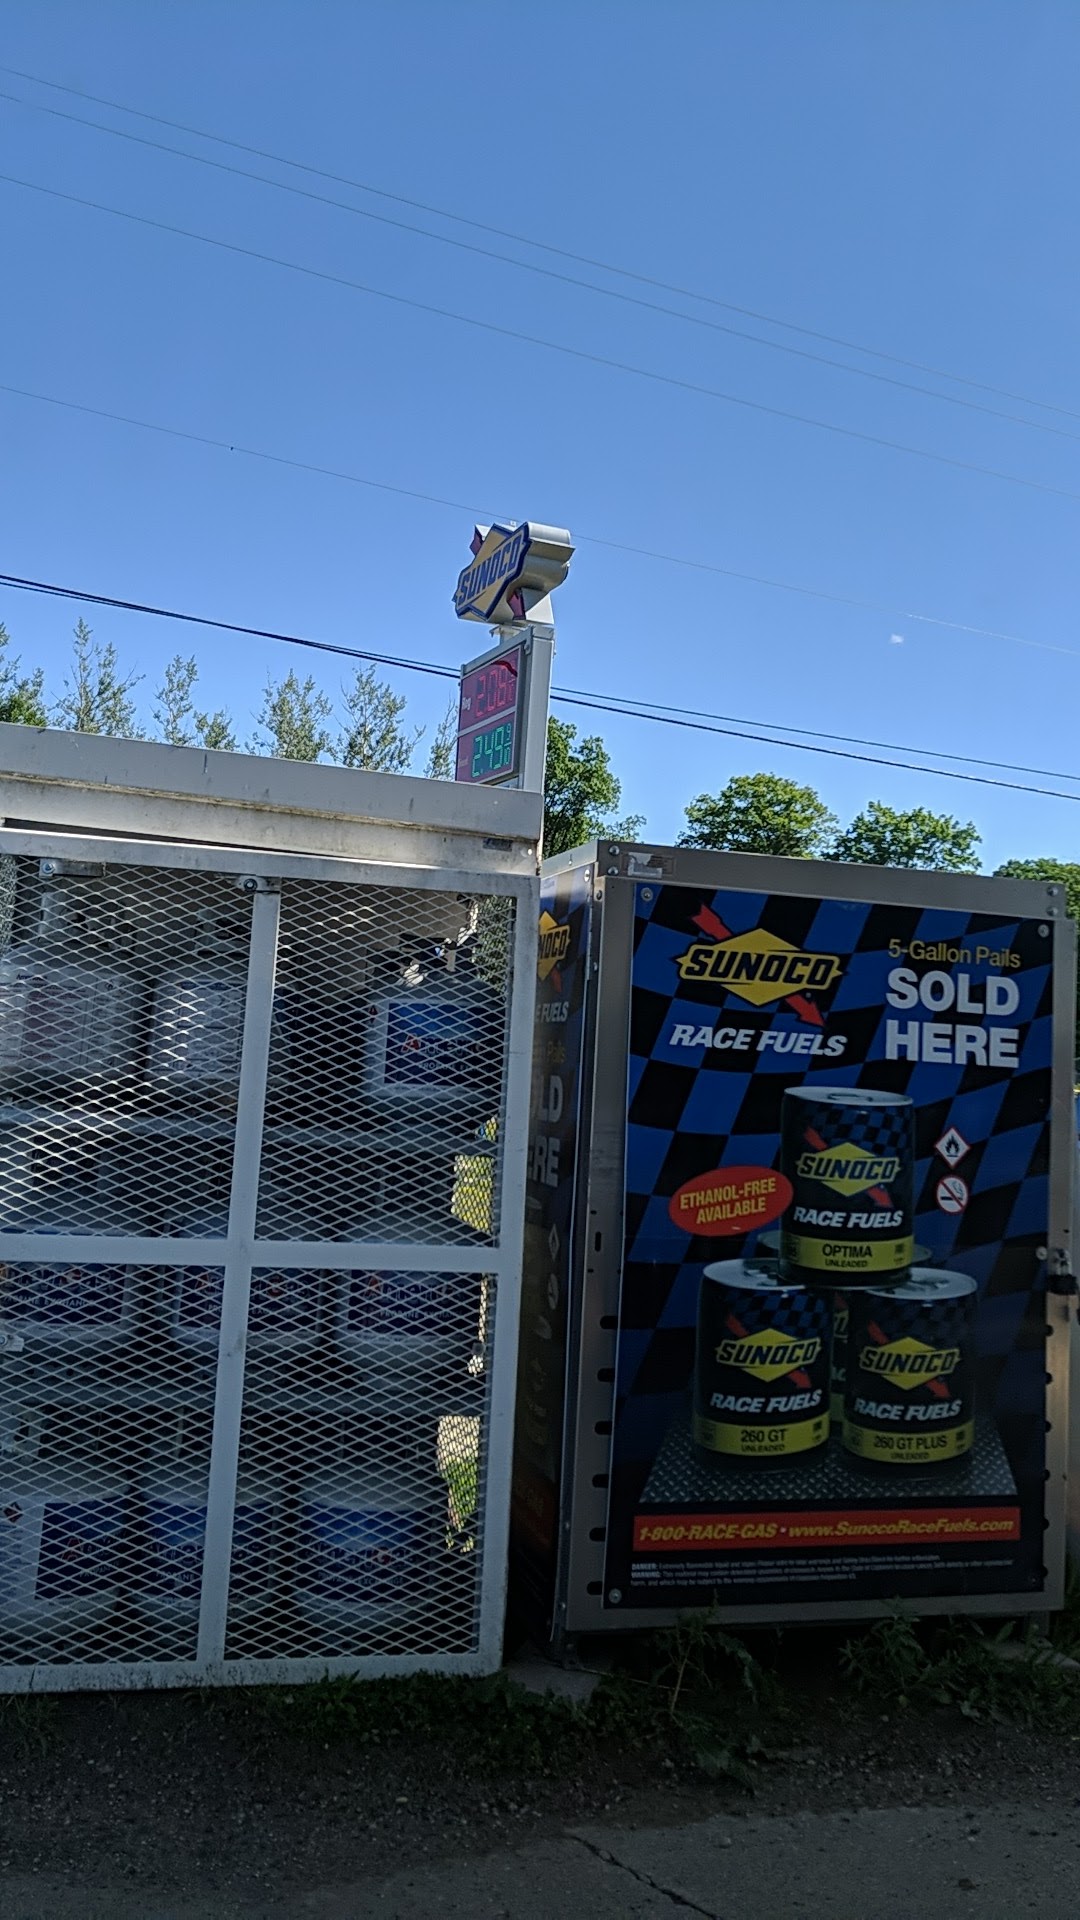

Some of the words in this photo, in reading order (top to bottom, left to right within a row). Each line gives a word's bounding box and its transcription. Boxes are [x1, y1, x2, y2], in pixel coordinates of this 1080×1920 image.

[458, 535, 522, 605] SUNOCO
[539, 930, 567, 960] NOCO
[888, 939, 971, 964] 5-Gallon
[975, 947, 1021, 969] Pails
[683, 948, 830, 989] SUNOCO
[886, 967, 1020, 1017] SOLD
[542, 1001, 569, 1024] FUELS
[669, 1023, 752, 1051] RACE
[756, 1030, 848, 1057] FUELS
[885, 1019, 1020, 1068] HERE
[535, 1075, 563, 1123] LD
[799, 1156, 898, 1183] SUNOCO
[679, 1178, 777, 1210] ETHANOL-FREE
[696, 1198, 767, 1224] AVAILABLE
[794, 1206, 844, 1229] RACE
[847, 1210, 903, 1229] FUELS
[822, 1243, 873, 1259] OPTIMA
[824, 1258, 869, 1268] UNLEADED
[718, 1339, 818, 1366] SUNOCO
[861, 1350, 957, 1375] SUNOCO
[710, 1392, 763, 1413] RACE
[766, 1390, 822, 1413] FUELS
[854, 1399, 902, 1421] RACE
[904, 1400, 962, 1421] FUELS
[741, 1429, 765, 1443] 260
[768, 1429, 788, 1443] GT
[896, 1437, 915, 1450] GT
[916, 1434, 947, 1449] PLUS
[639, 1523, 778, 1541] 1-800-RACE-GAS
[788, 1518, 1014, 1538] www.SunocoRaceFuels.com
